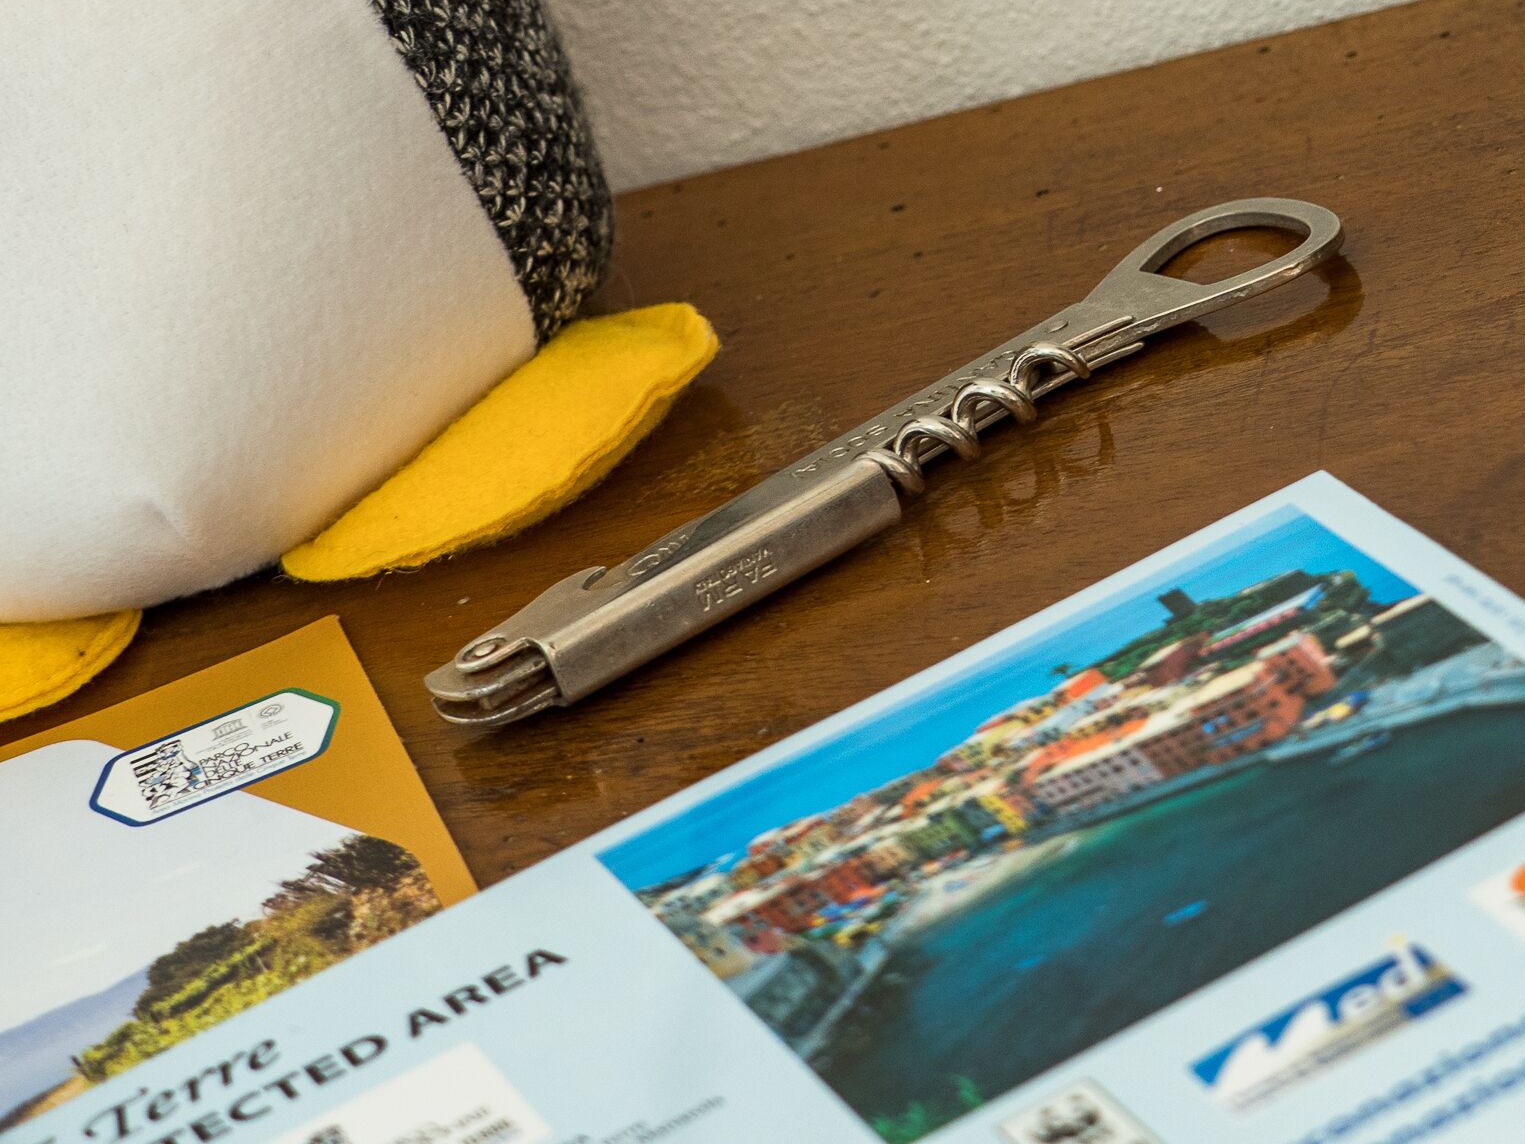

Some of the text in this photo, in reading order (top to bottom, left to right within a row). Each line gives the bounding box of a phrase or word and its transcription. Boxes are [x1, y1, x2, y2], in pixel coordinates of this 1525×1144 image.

[193, 762, 257, 791] CINQUE
[260, 741, 304, 765] TERRE
[200, 742, 250, 766] PARCO
[202, 731, 295, 773] NAZIONALE
[406, 947, 569, 1039] AREA
[82, 1038, 284, 1142] Terre
